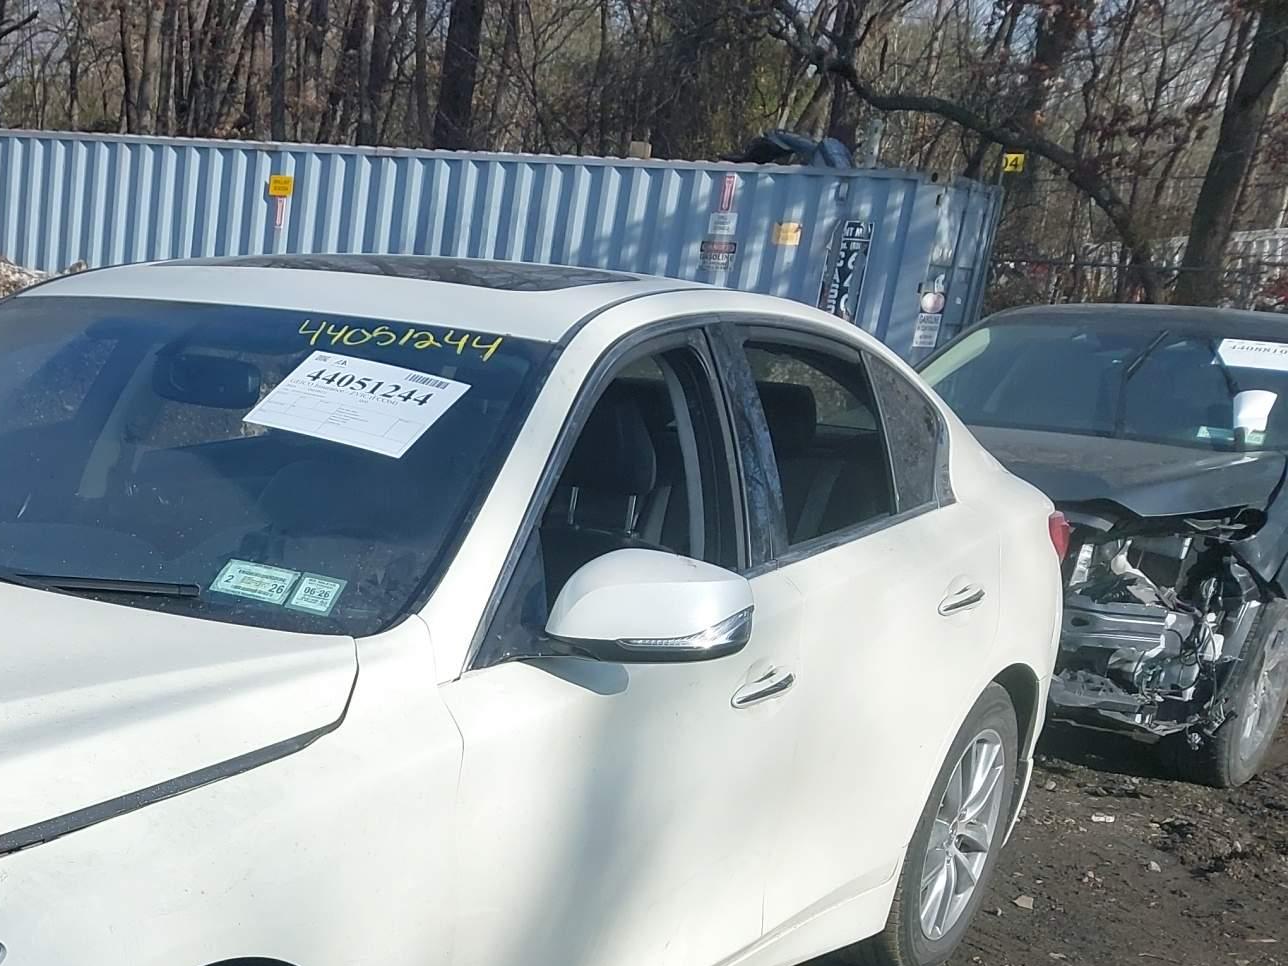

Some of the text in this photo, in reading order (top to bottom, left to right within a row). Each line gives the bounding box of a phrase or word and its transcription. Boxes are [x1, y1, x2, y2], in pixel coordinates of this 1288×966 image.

[298, 319, 504, 362] 44051244
[306, 368, 434, 406] 44051244
[224, 575, 234, 583] 2
[268, 583, 285, 594] 26
